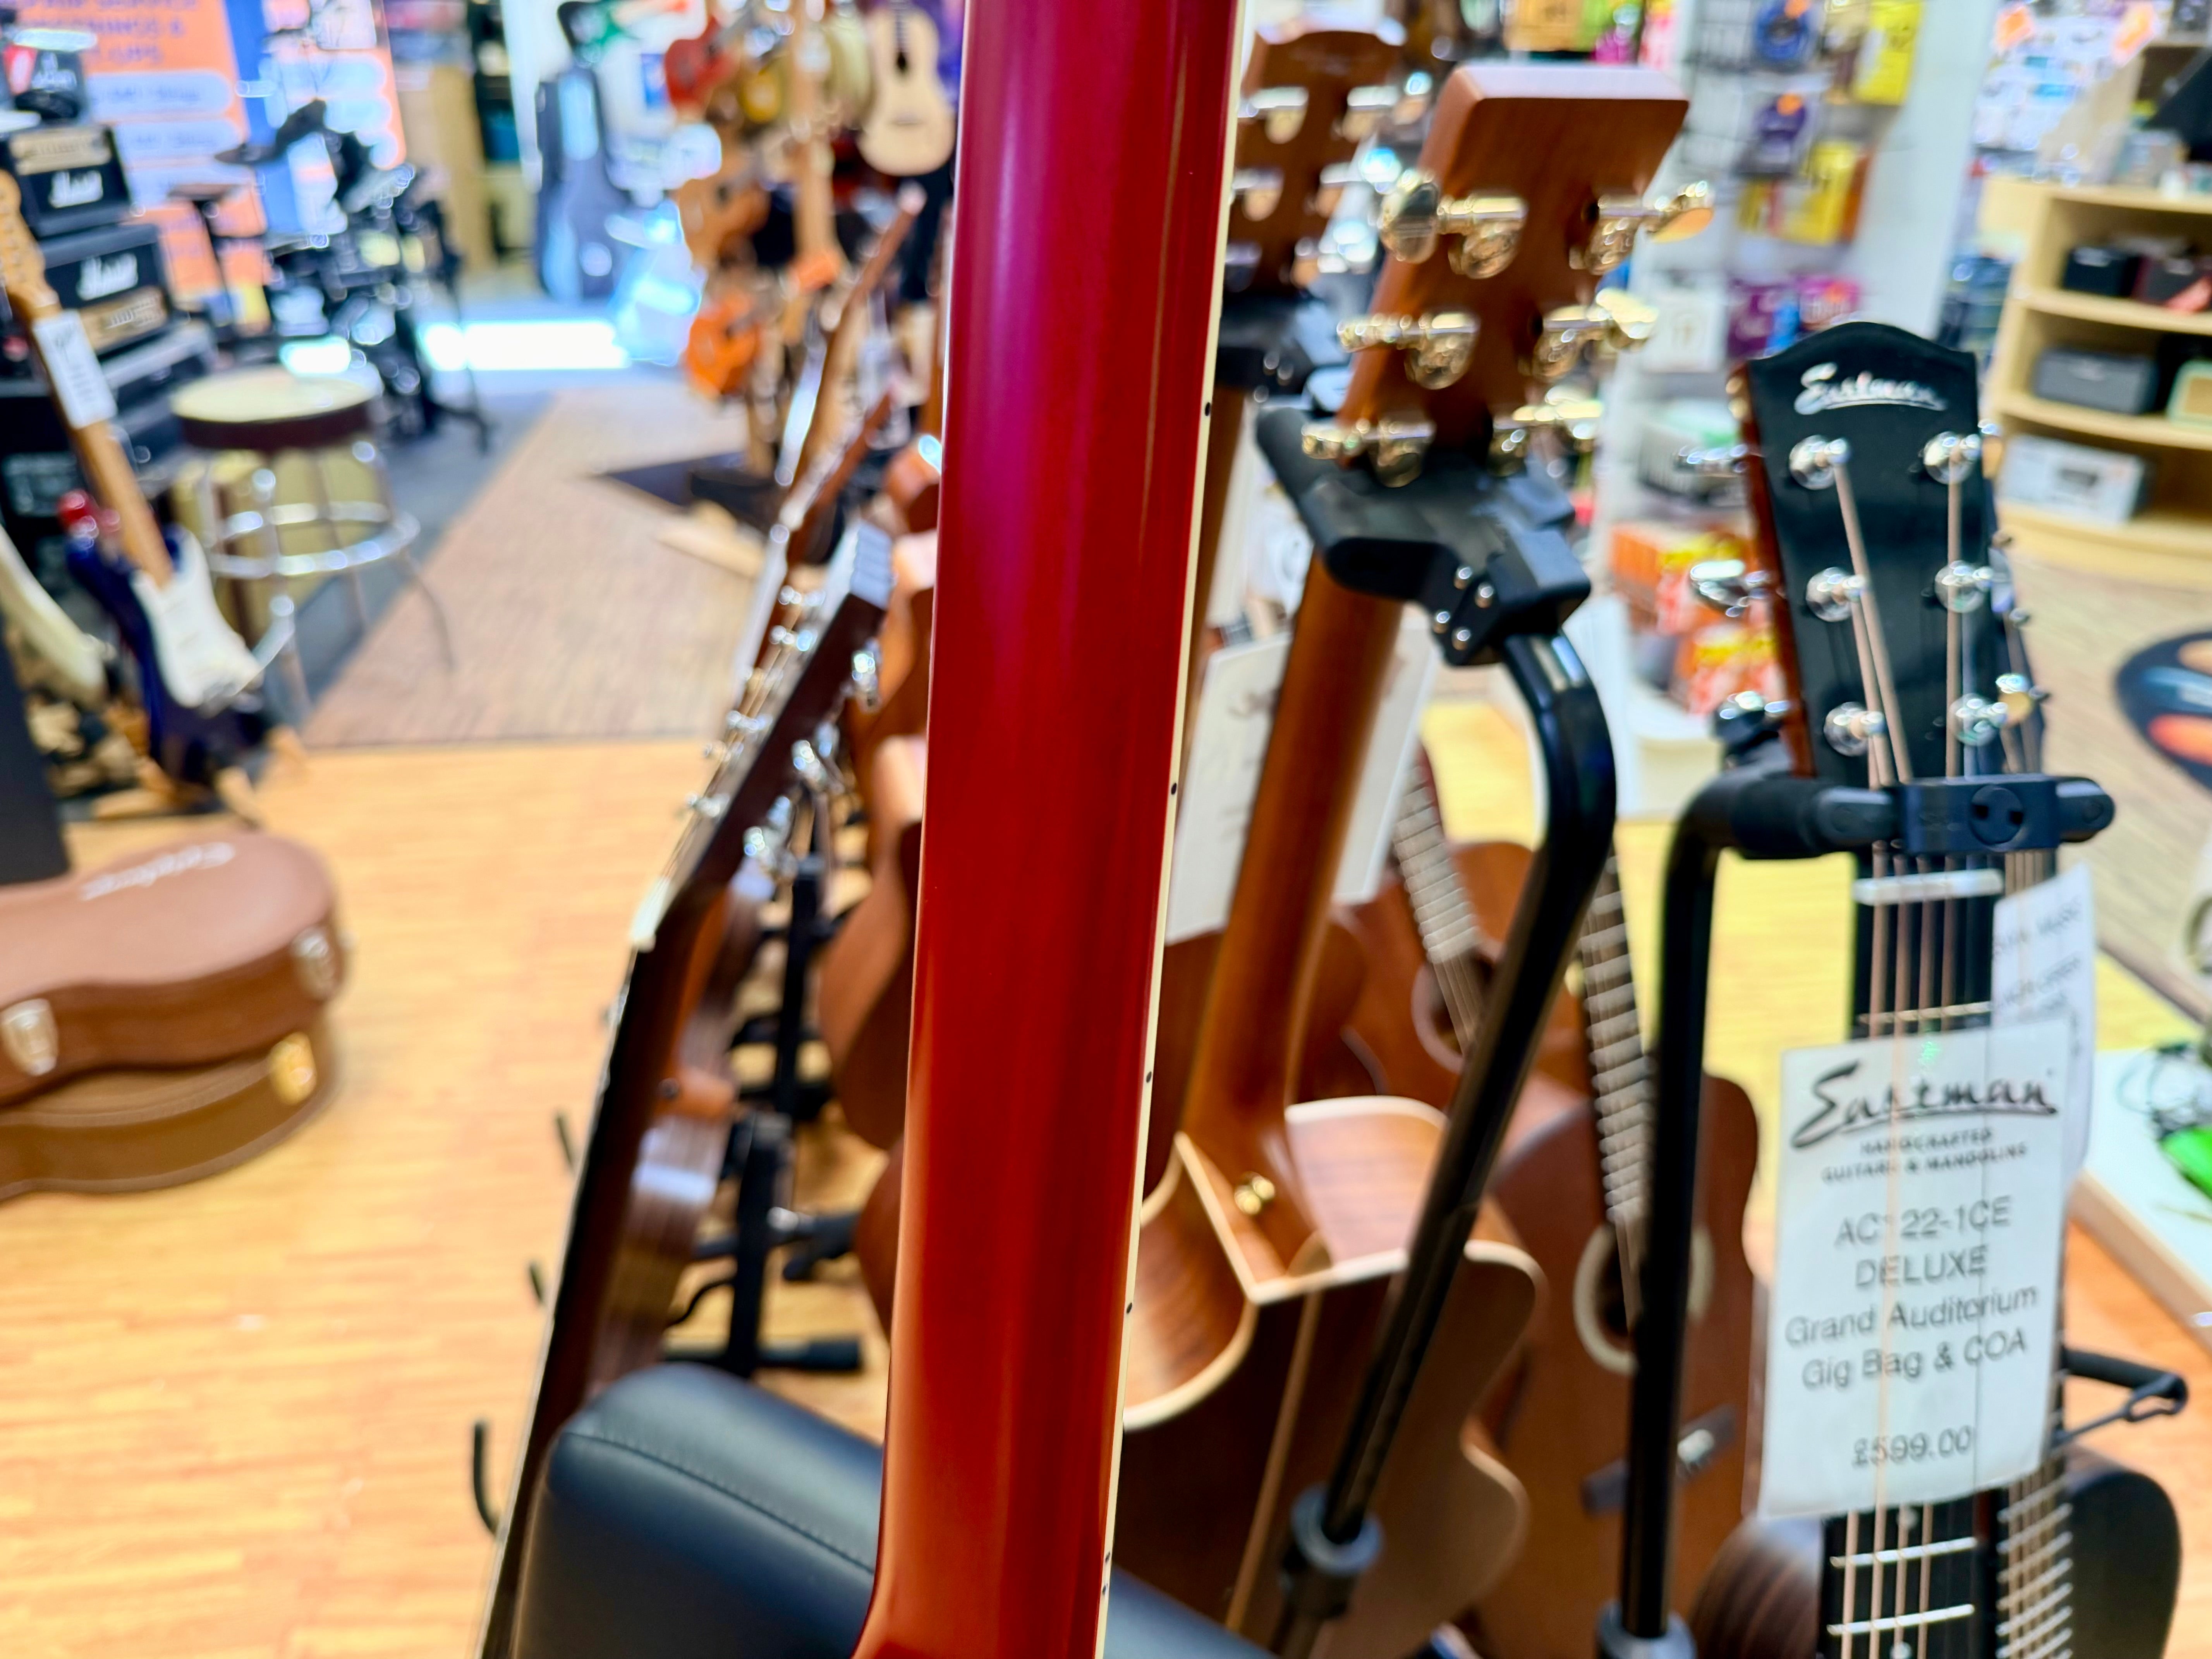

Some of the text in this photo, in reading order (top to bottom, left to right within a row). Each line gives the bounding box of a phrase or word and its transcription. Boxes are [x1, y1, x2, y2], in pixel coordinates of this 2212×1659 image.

[1790, 1059, 2057, 1149] Eastman
[1822, 1159, 1899, 1183] GUITAR
[1834, 1194, 2012, 1248] AC22-1CE
[1855, 1244, 1989, 1290] DELUXE
[1784, 1285, 2038, 1347] Grand Auditorium
[1802, 1325, 2028, 1390] Gig Bag & COA
[1852, 1425, 1973, 1468] £599.00
